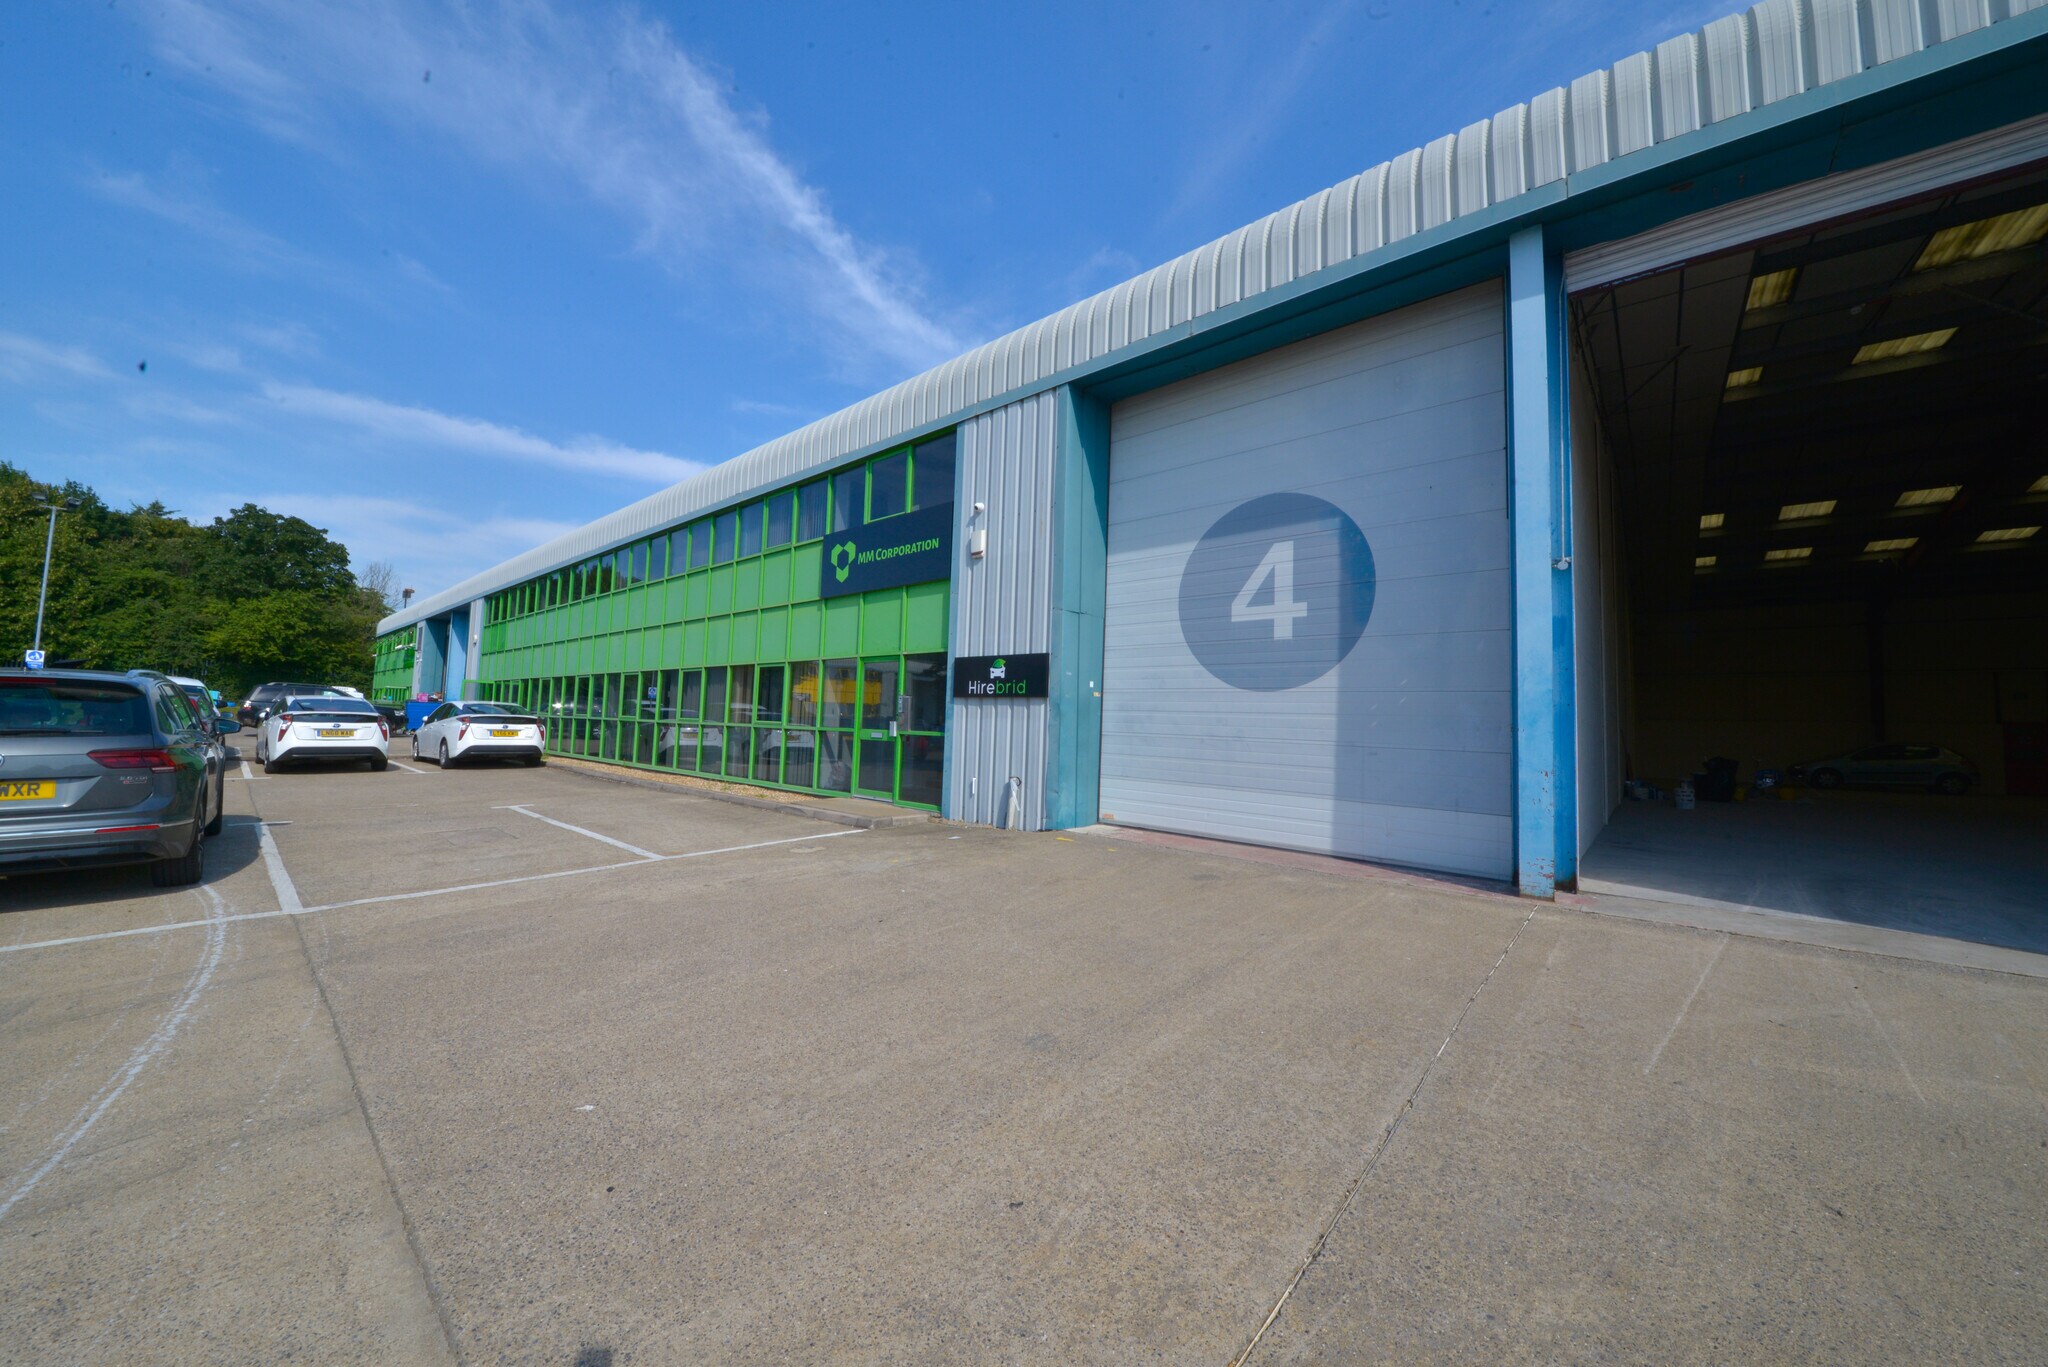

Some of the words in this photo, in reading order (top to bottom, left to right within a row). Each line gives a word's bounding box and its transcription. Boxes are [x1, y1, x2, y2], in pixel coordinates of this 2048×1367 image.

[858, 549, 874, 565] MM
[875, 537, 940, 561] CORPORATION
[1231, 540, 1308, 640] 4
[968, 680, 1026, 694] Hirebrid
[0, 783, 40, 797] WXR
